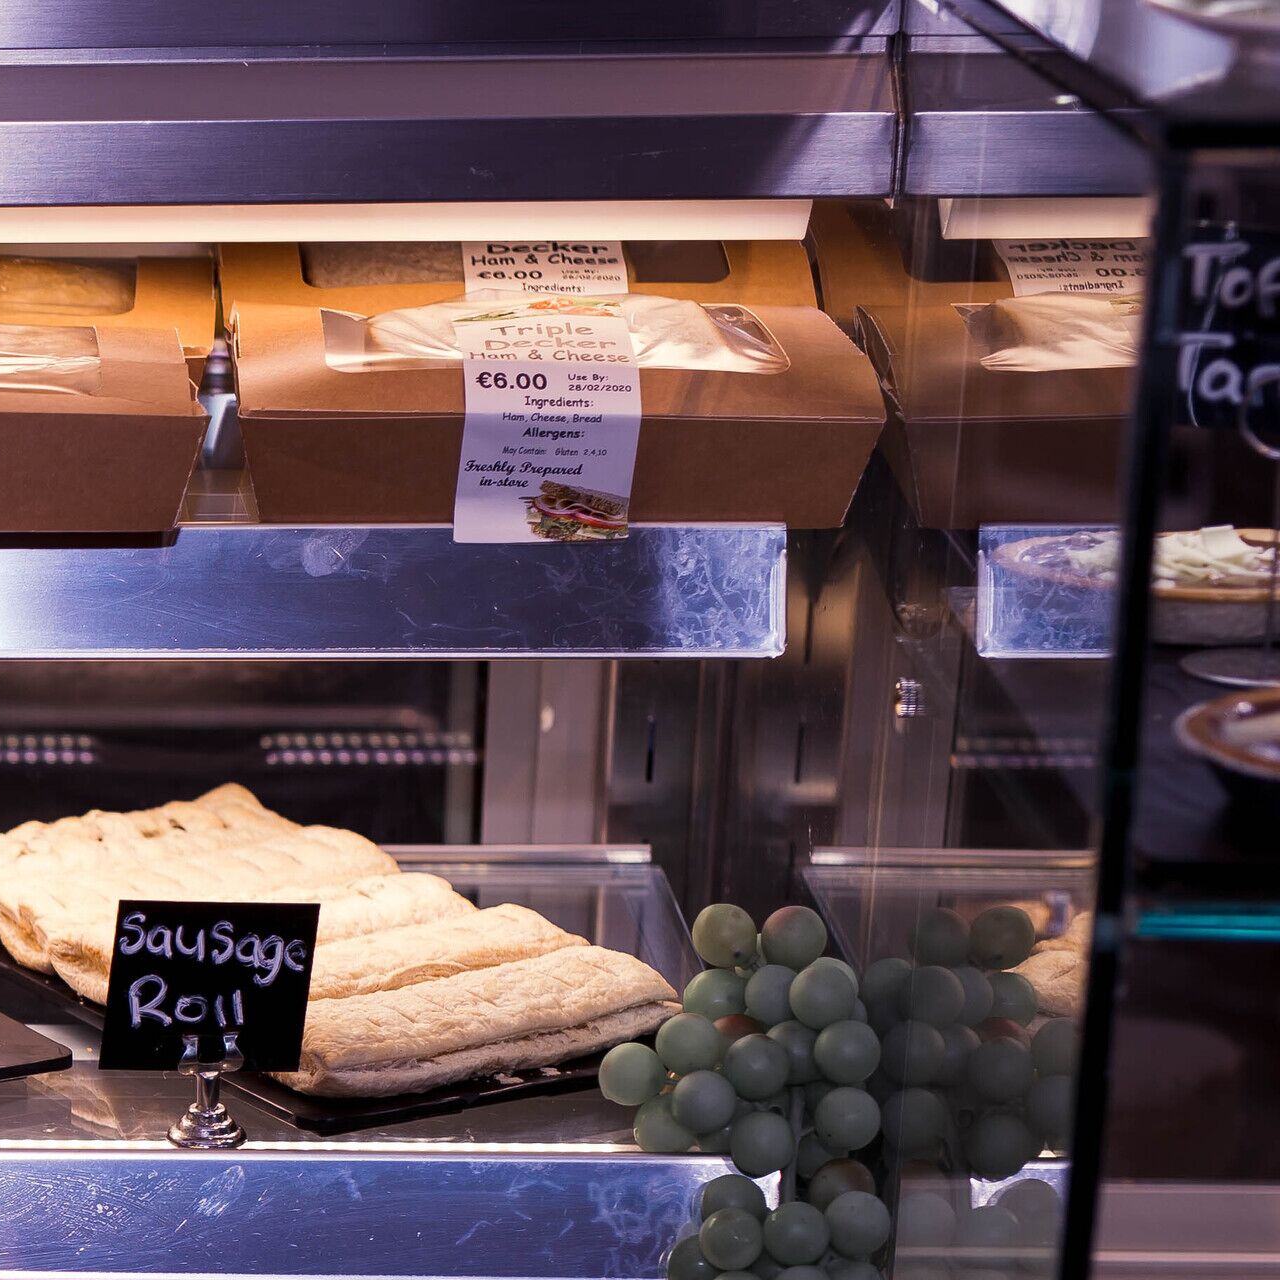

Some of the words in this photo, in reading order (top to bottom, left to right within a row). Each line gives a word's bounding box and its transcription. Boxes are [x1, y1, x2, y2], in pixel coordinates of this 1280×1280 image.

[471, 255, 517, 266] Ham
[525, 255, 539, 266] &
[548, 253, 619, 266] Cheese
[490, 322, 594, 337] Triple
[484, 337, 617, 350] Decker
[469, 351, 517, 361] Ham
[528, 350, 544, 361] &
[552, 350, 630, 364] Cheese
[475, 372, 548, 391] €6.00
[524, 396, 594, 409] Ingredients:
[502, 412, 527, 424] Ham,
[530, 413, 569, 425] Cheese,
[572, 414, 603, 424] Bread
[522, 427, 585, 441] Allergens:
[464, 460, 516, 474] Freshly
[519, 461, 584, 478] Prepared
[479, 476, 529, 489] in-store
[128, 974, 244, 1029] Roll
